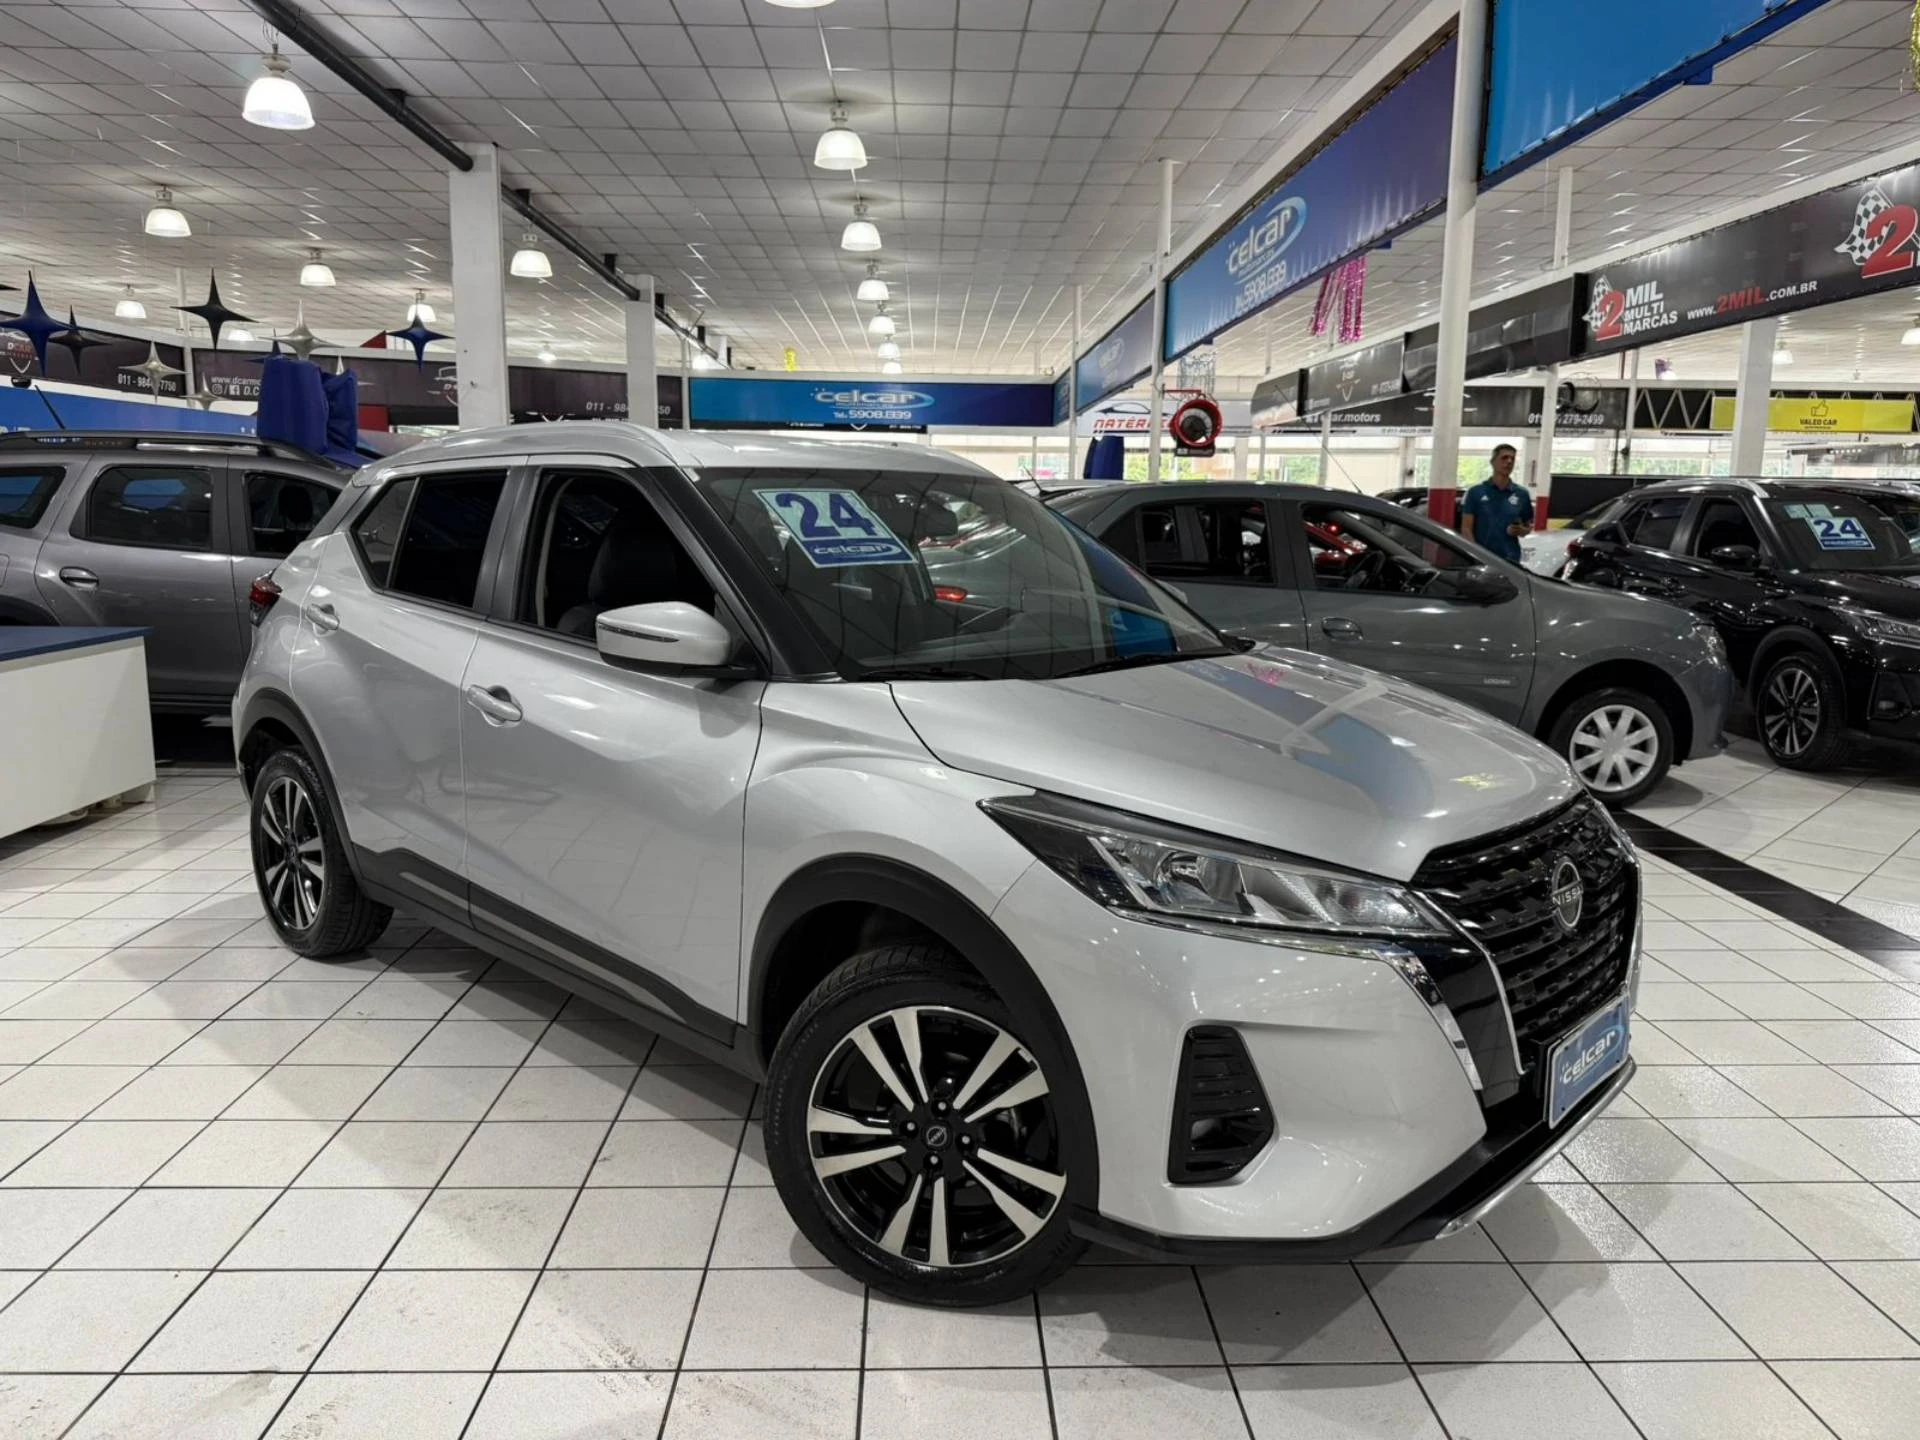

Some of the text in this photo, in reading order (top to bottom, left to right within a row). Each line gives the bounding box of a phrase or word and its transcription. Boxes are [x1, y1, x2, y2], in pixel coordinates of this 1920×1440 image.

[1228, 207, 1293, 274] celcar
[1860, 204, 1918, 279] 2
[1595, 280, 1664, 341] 2 MIL
[1624, 300, 1665, 321] MULTI
[1624, 310, 1678, 336] MARCAS
[117, 373, 131, 386] 011
[585, 401, 604, 411] 011
[815, 389, 916, 404] celcar
[775, 493, 878, 538] 24
[1813, 518, 1864, 538] 24
[813, 544, 890, 555] celcar
[1563, 1030, 1616, 1085] celcar
